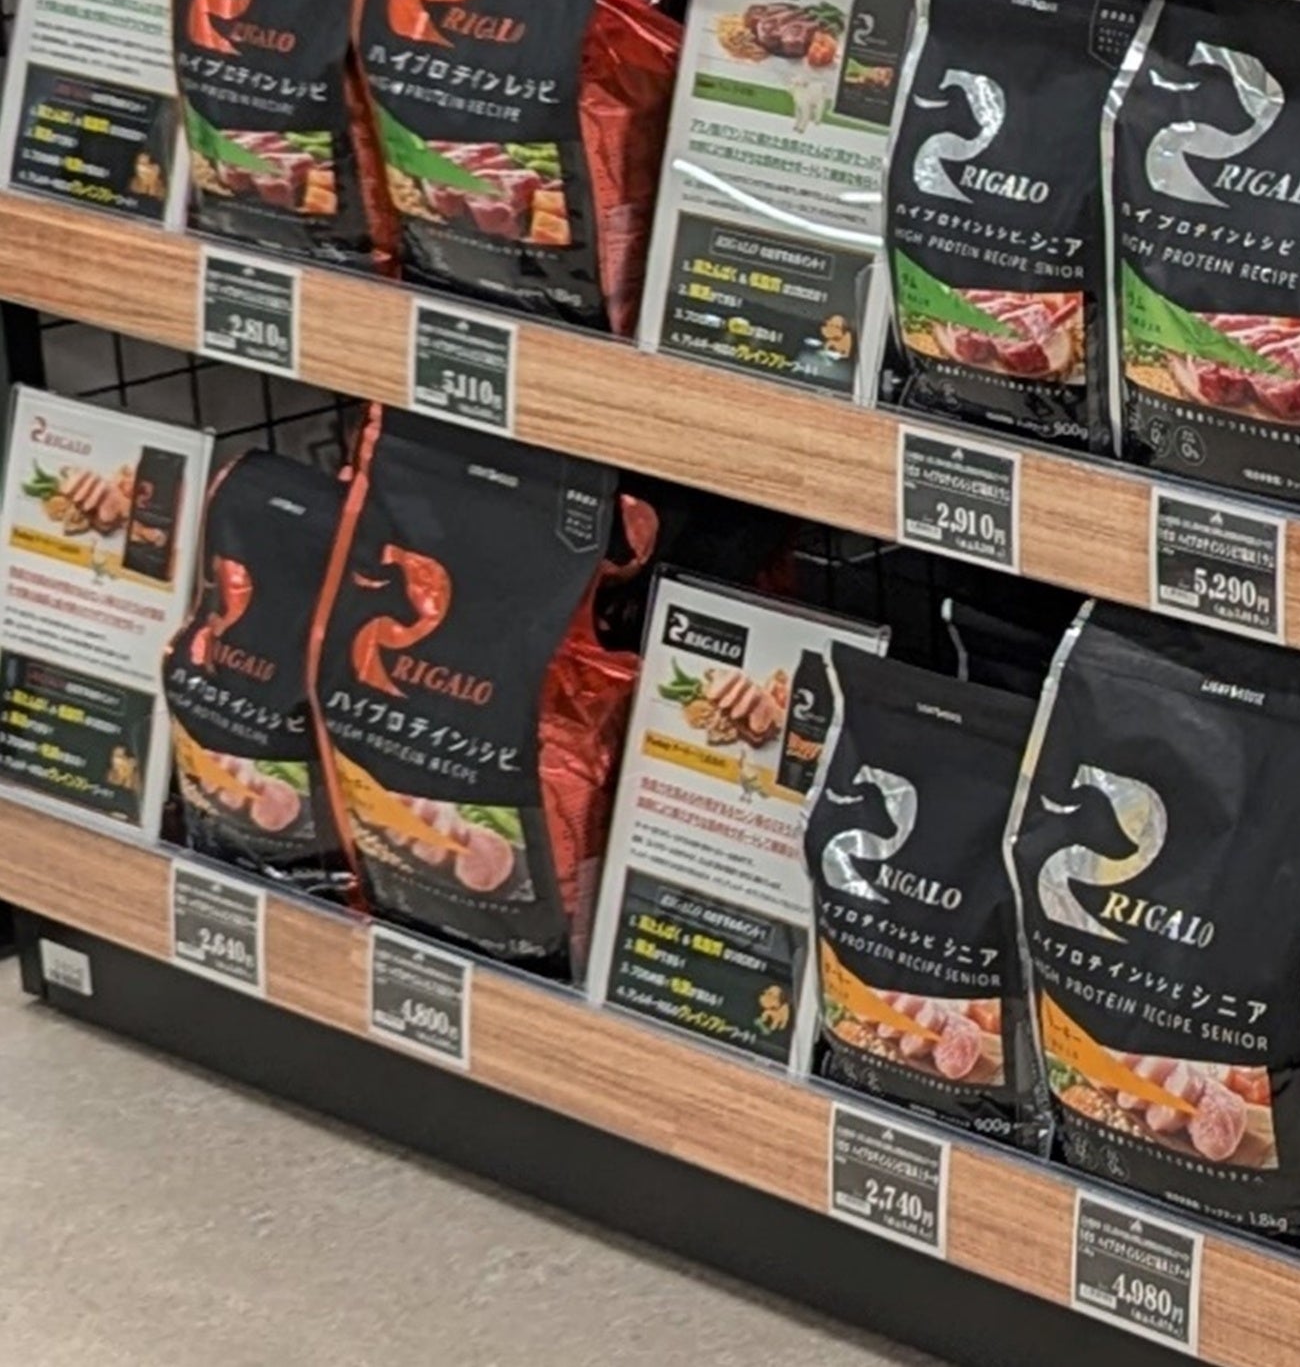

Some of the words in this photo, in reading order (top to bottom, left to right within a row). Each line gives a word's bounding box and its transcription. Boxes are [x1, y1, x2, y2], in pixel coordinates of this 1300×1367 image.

[959, 165, 1050, 205] RIGALO
[927, 233, 981, 265] PROTEIN
[985, 247, 1029, 274] RECIPE
[1030, 235, 1083, 261] シニア
[1161, 245, 1236, 279] PROTEIN
[1240, 261, 1298, 291] RECIPE
[935, 501, 1007, 543] 2,910円
[1192, 566, 1270, 615] 5,290円
[391, 654, 495, 707] RIGALO
[874, 864, 964, 911] RIGALO
[1098, 888, 1215, 951] RIGALO
[942, 937, 999, 968] シニア
[1065, 969, 1138, 1019] PROTEIN
[1201, 1018, 1269, 1053] SENIOR
[1190, 983, 1267, 1026] シニア
[864, 1175, 935, 1228] 2,740円
[1246, 1207, 1289, 1231] 1.8kg
[1111, 1267, 1185, 1326] 4,980円
